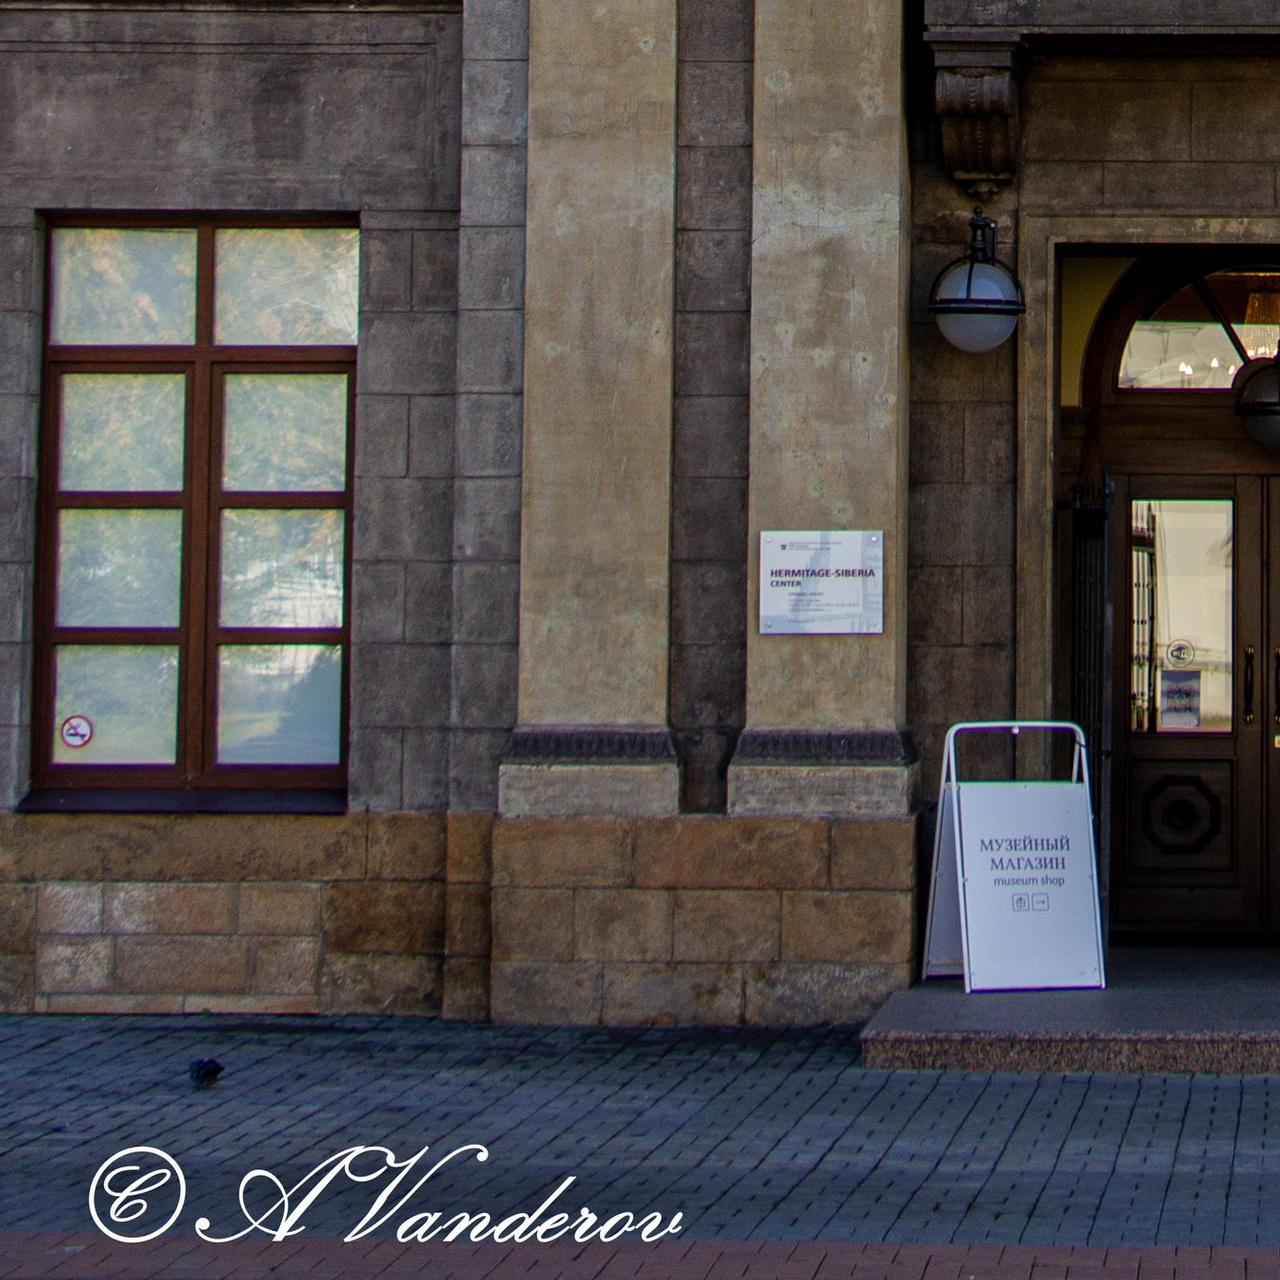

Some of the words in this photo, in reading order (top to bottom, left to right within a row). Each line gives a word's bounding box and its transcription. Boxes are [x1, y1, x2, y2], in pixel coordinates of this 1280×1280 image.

[770, 569, 875, 578] HERMITAGE-SIBERIA
[980, 835, 1071, 852] МУЗЕЙНЫЙ
[990, 857, 1065, 870] МАГАЗИН
[994, 876, 1039, 886] museum
[1040, 874, 1065, 887] shop
